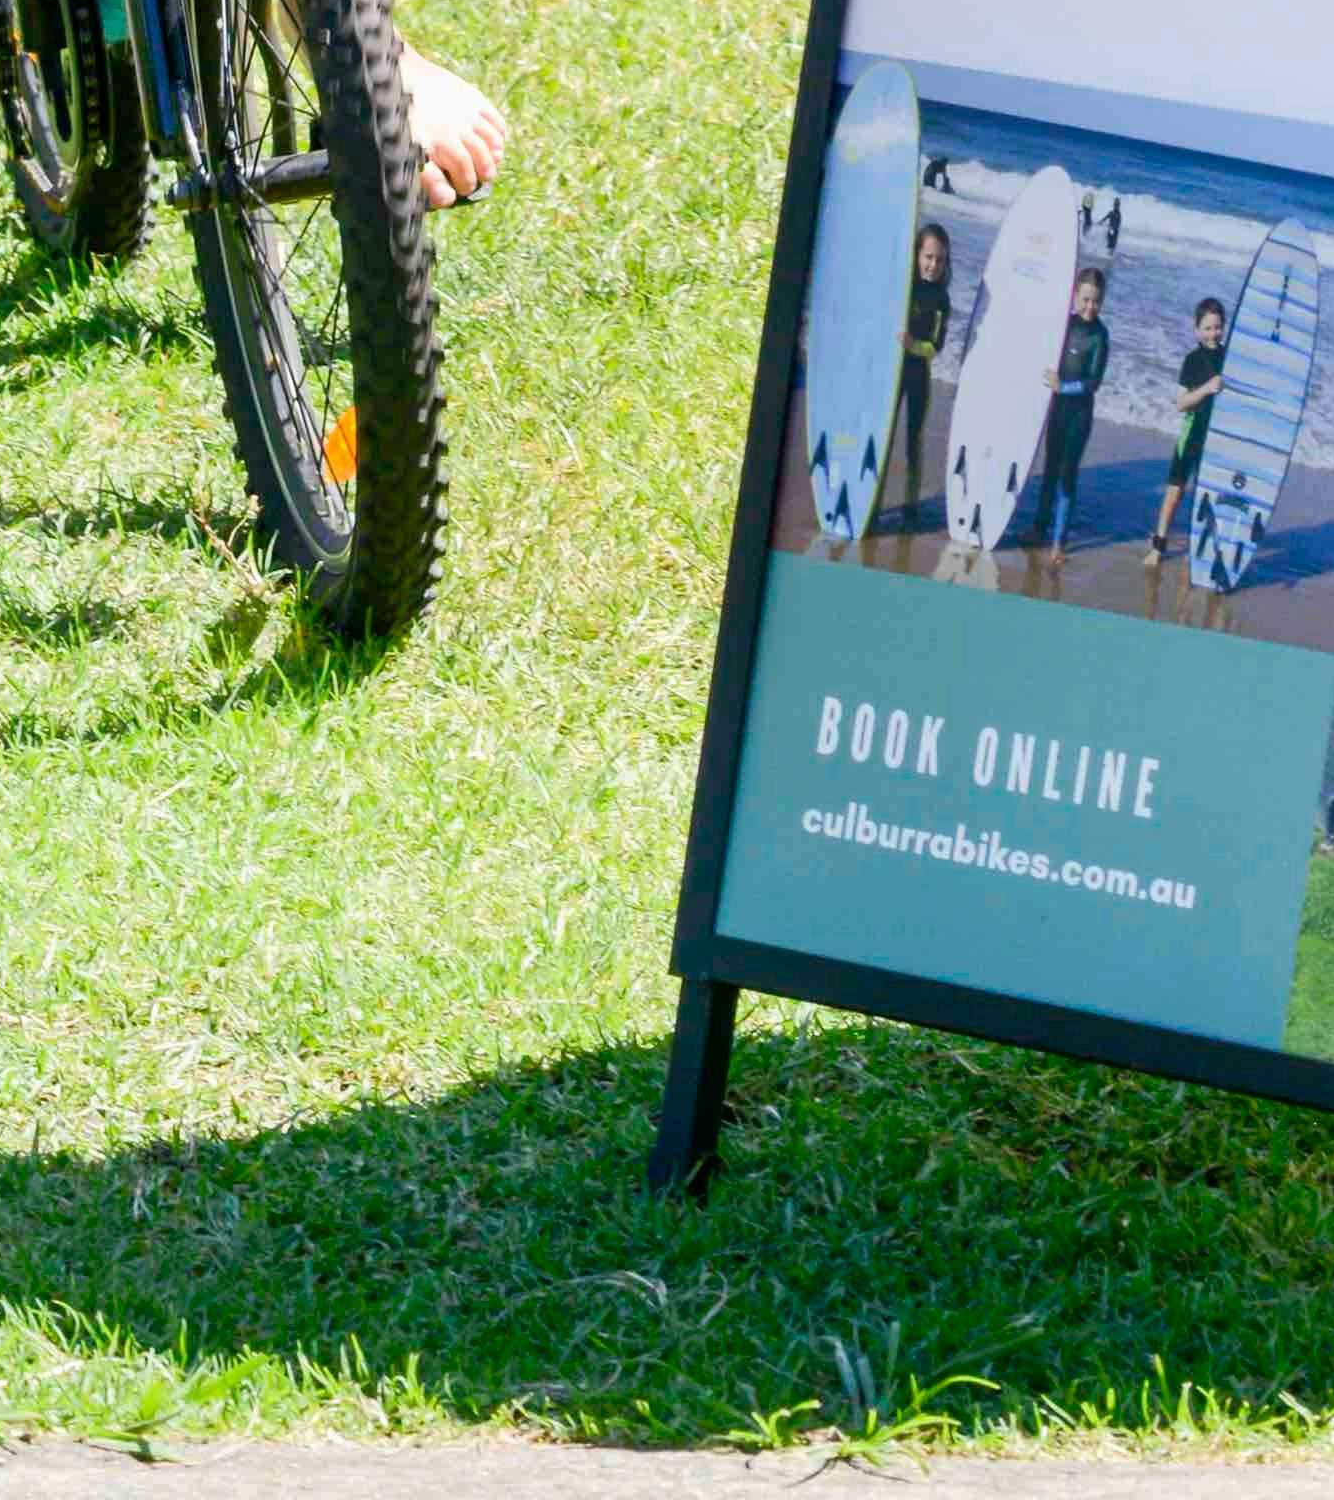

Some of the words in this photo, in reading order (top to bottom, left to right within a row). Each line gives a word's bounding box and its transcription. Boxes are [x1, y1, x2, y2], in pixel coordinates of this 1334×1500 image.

[816, 696, 946, 778] BOOK
[973, 727, 1161, 820] ONLINE
[801, 801, 1197, 910] culburrabikes.com.au
